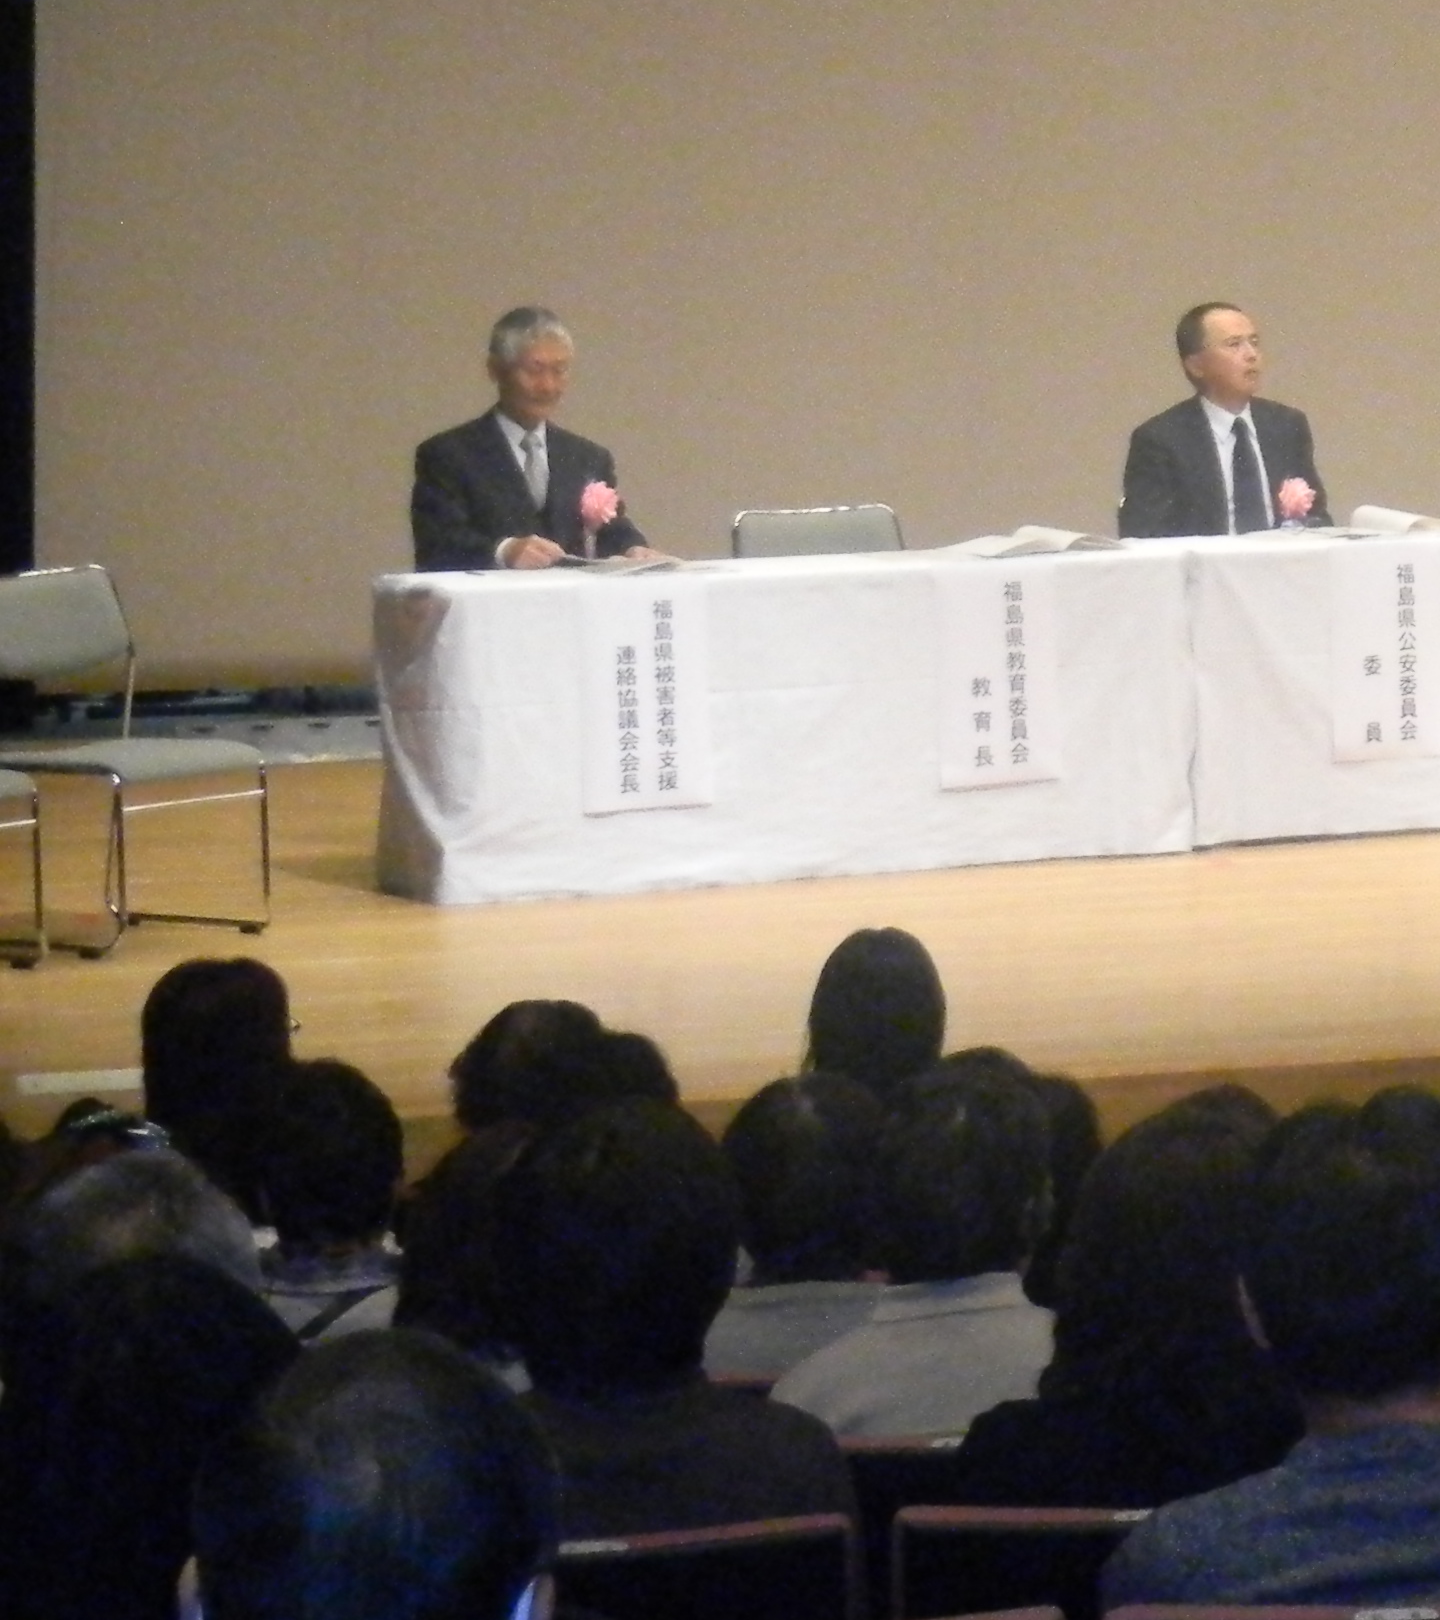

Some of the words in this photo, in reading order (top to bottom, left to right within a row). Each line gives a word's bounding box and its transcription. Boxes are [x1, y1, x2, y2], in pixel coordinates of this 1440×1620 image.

[616, 645, 640, 794] 連絡協議会会長
[653, 599, 678, 792] 福島県被害者等支援
[971, 677, 994, 768] 教育長
[1003, 581, 1029, 765] 福島県教育委員会
[1364, 654, 1382, 743] 委員
[1397, 563, 1418, 741] 福島県公安委員会
